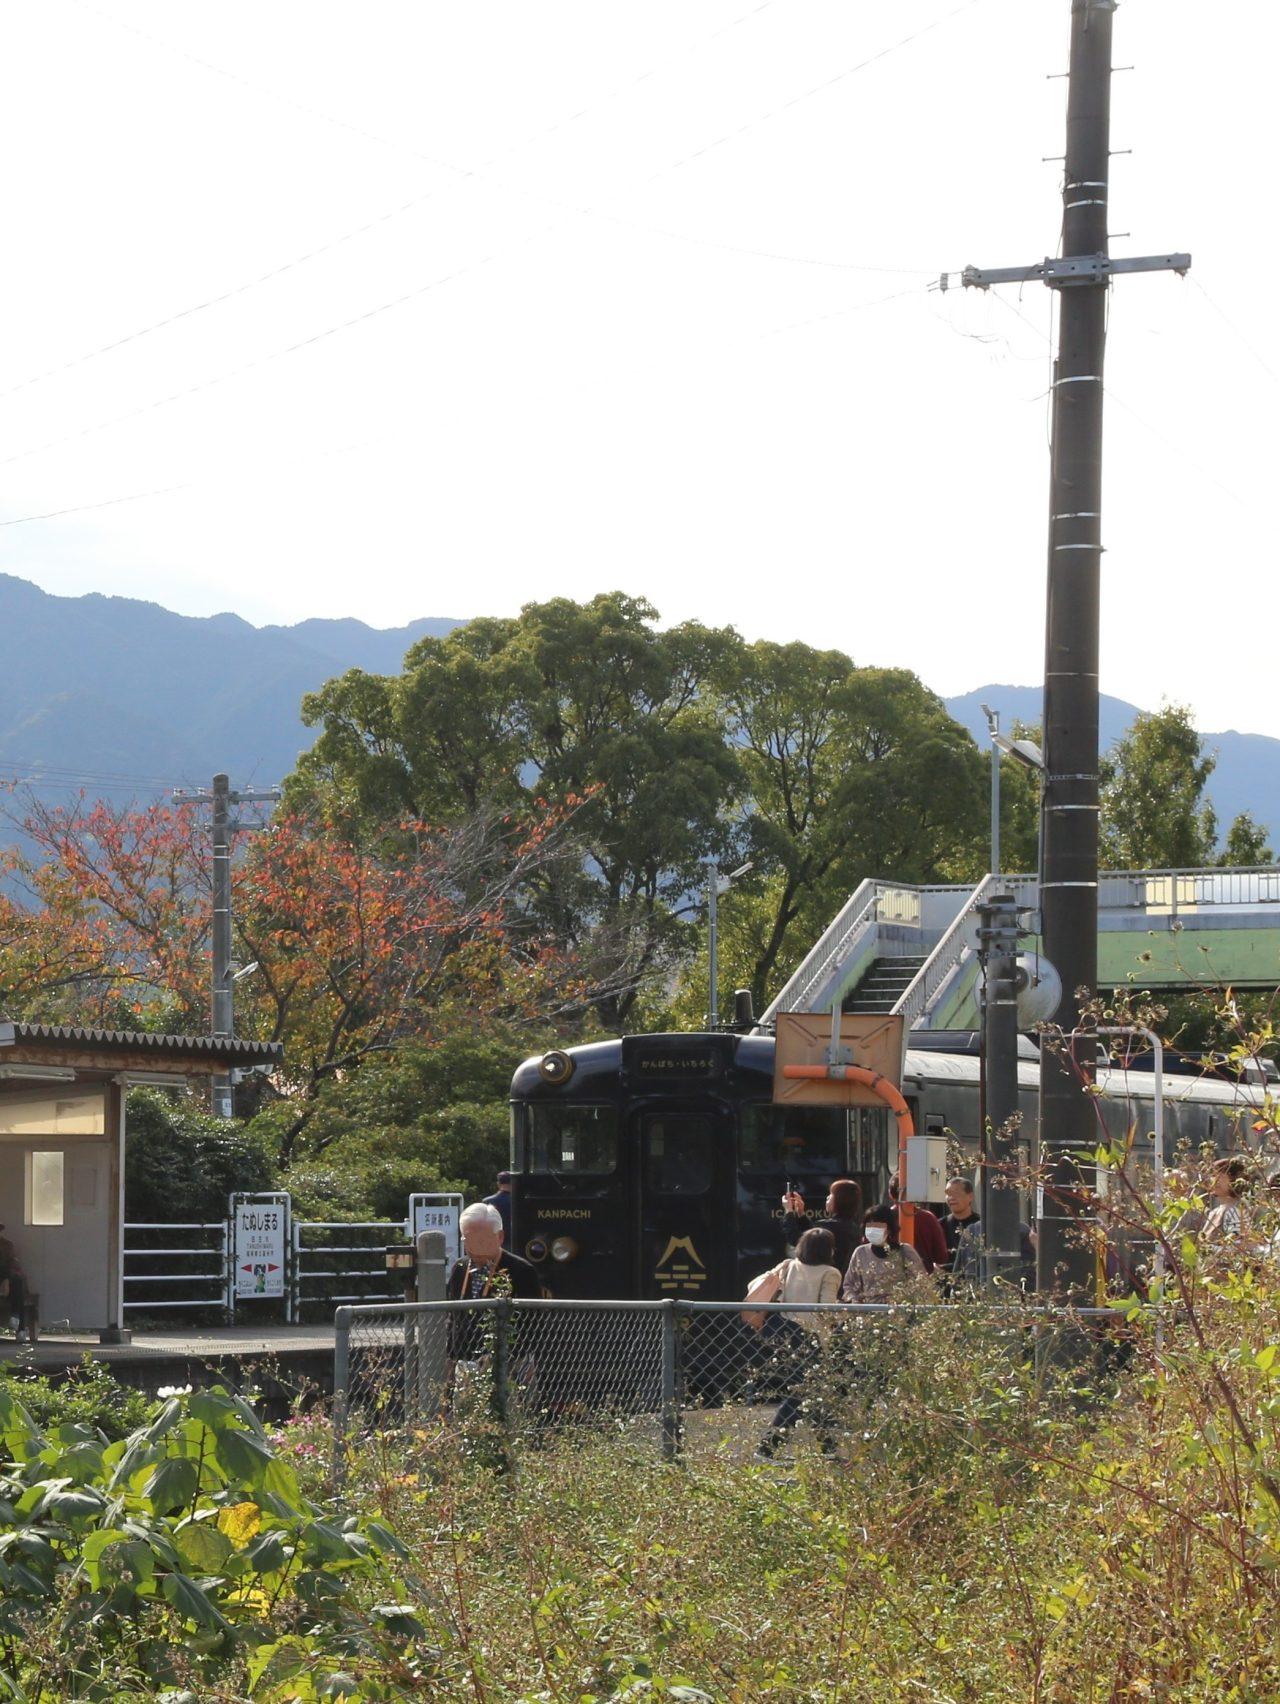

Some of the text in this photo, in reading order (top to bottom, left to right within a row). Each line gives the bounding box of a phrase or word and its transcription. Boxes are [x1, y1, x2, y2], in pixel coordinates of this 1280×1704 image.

[242, 1211, 278, 1231] たぬしまる
[537, 1208, 591, 1219] KANPACHI
